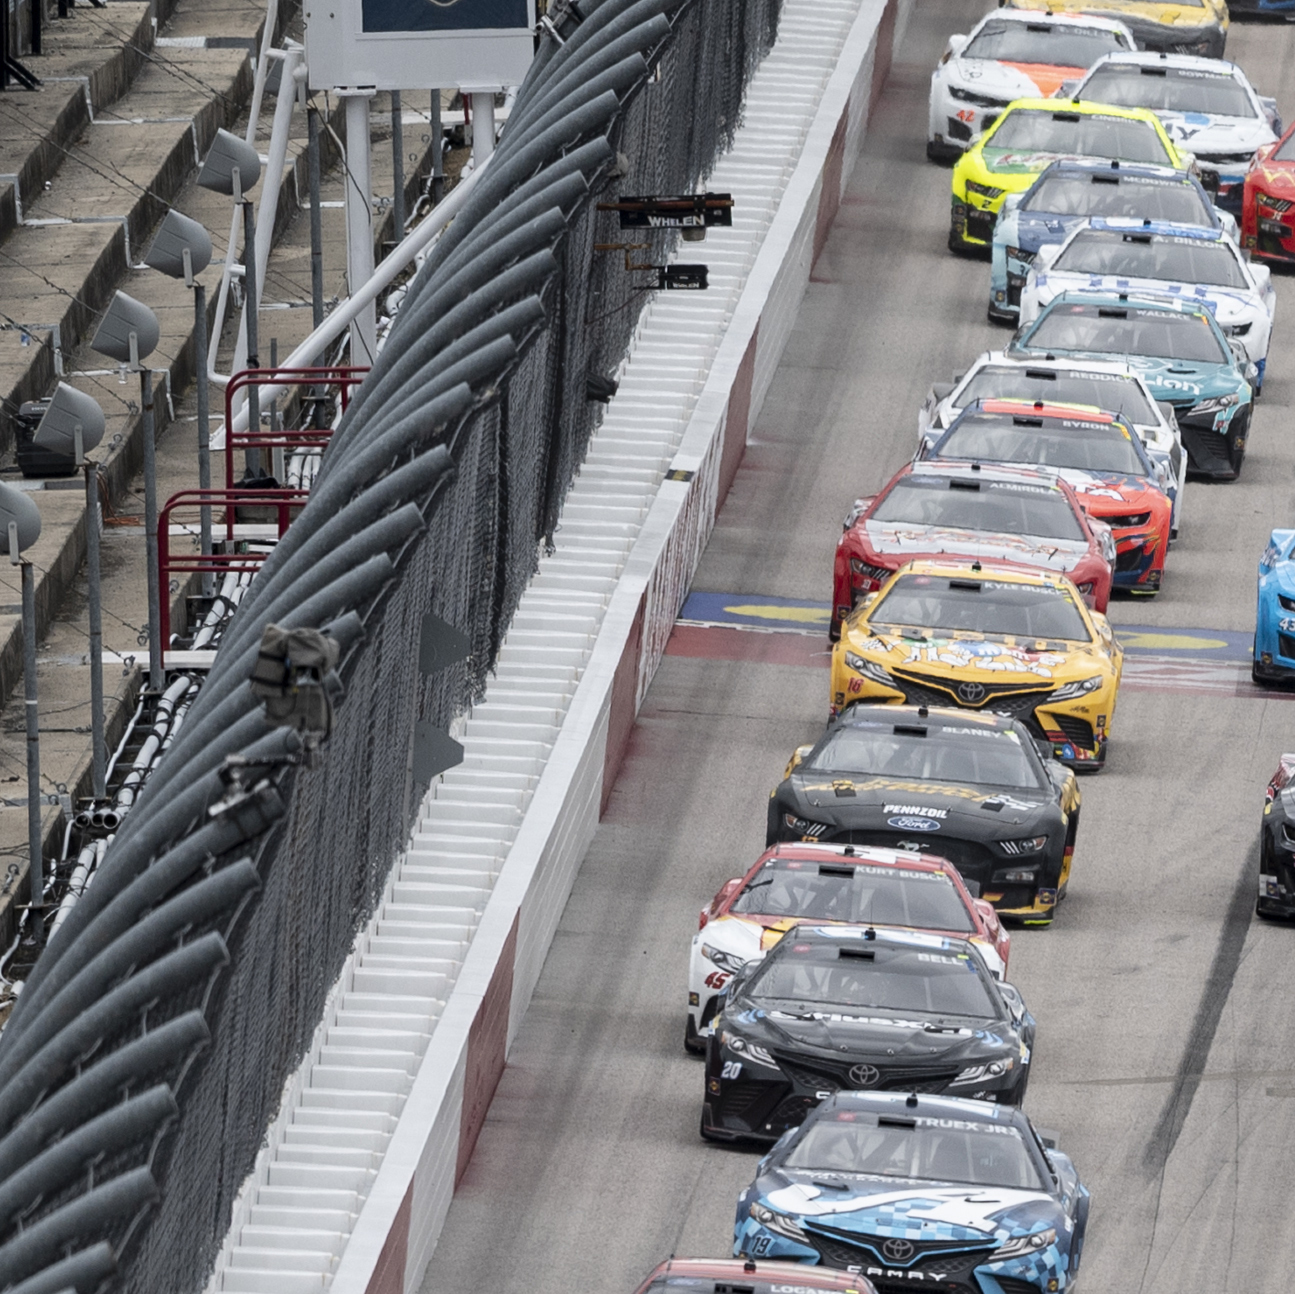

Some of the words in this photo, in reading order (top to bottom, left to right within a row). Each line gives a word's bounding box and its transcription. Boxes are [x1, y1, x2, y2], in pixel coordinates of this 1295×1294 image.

[956, 110, 975, 123] 42
[647, 214, 705, 226] WHELEN
[1136, 309, 1191, 321] WALLACE
[1063, 420, 1110, 431] BYRON
[984, 582, 1019, 591] KYLE
[942, 726, 1003, 738] BLANEY
[883, 804, 949, 819] PENNZOIL
[855, 865, 897, 877] KURT
[918, 952, 964, 966] BELL
[704, 971, 731, 990] 45
[721, 1060, 743, 1080] 20
[913, 1116, 980, 1131] TRUEX
[752, 1236, 772, 1255] 19
[846, 1264, 948, 1281] CAMRY
